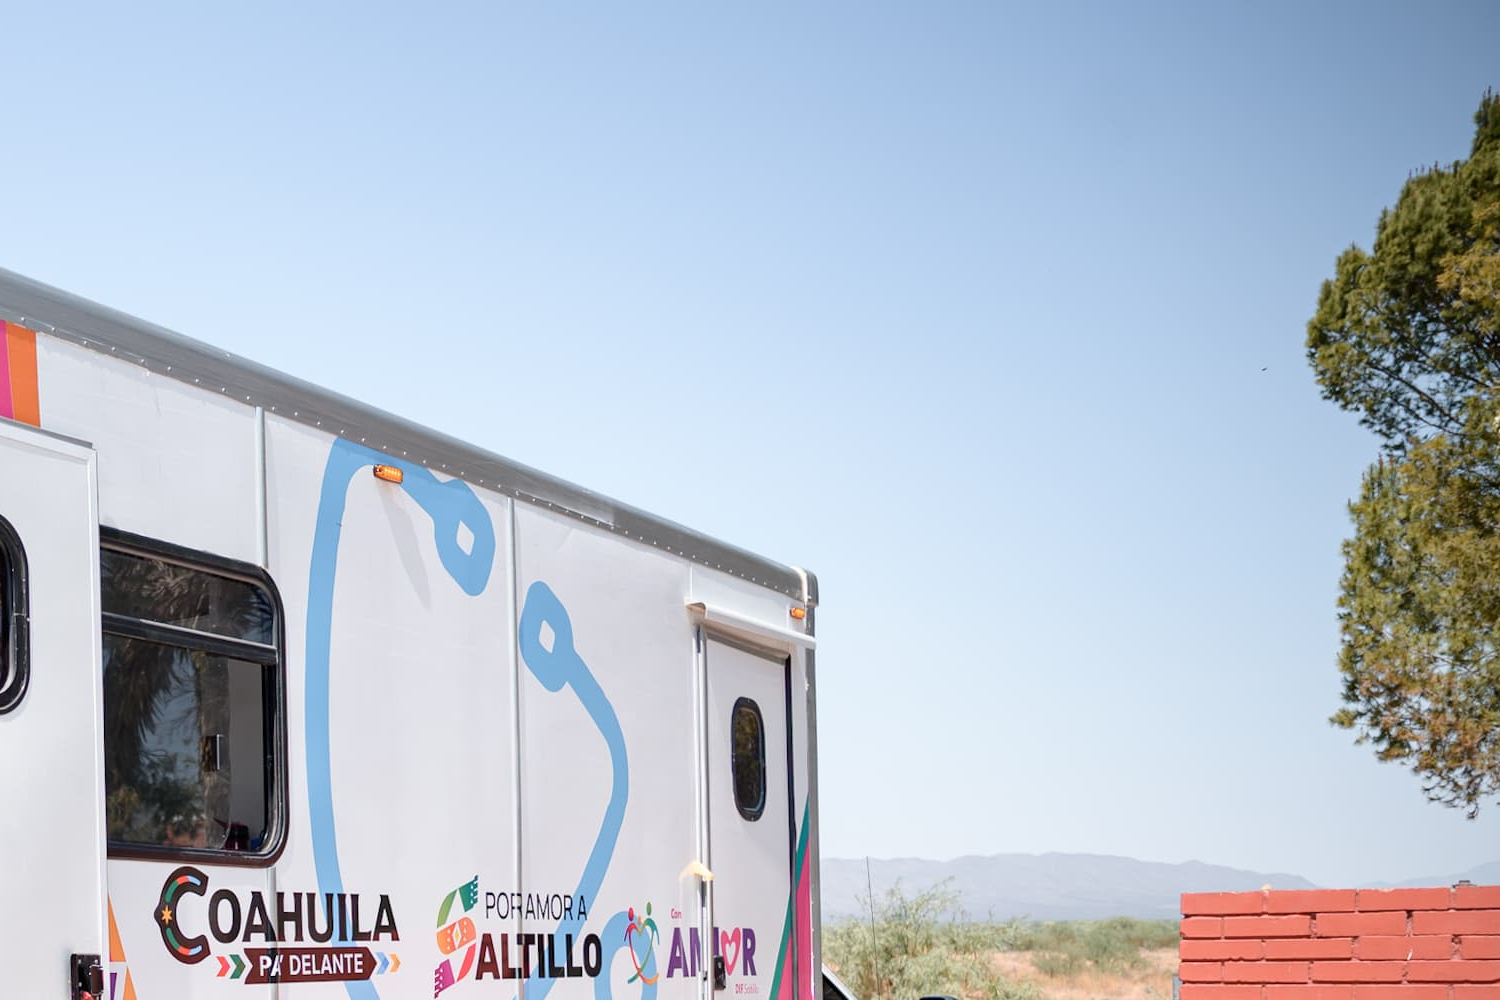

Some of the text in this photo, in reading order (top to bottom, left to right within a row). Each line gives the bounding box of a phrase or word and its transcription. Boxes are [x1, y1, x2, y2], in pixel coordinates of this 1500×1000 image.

[525, 893, 573, 921] AMOR
[577, 895, 588, 921] A
[670, 908, 682, 919] Con
[289, 953, 364, 975] DELANTE
